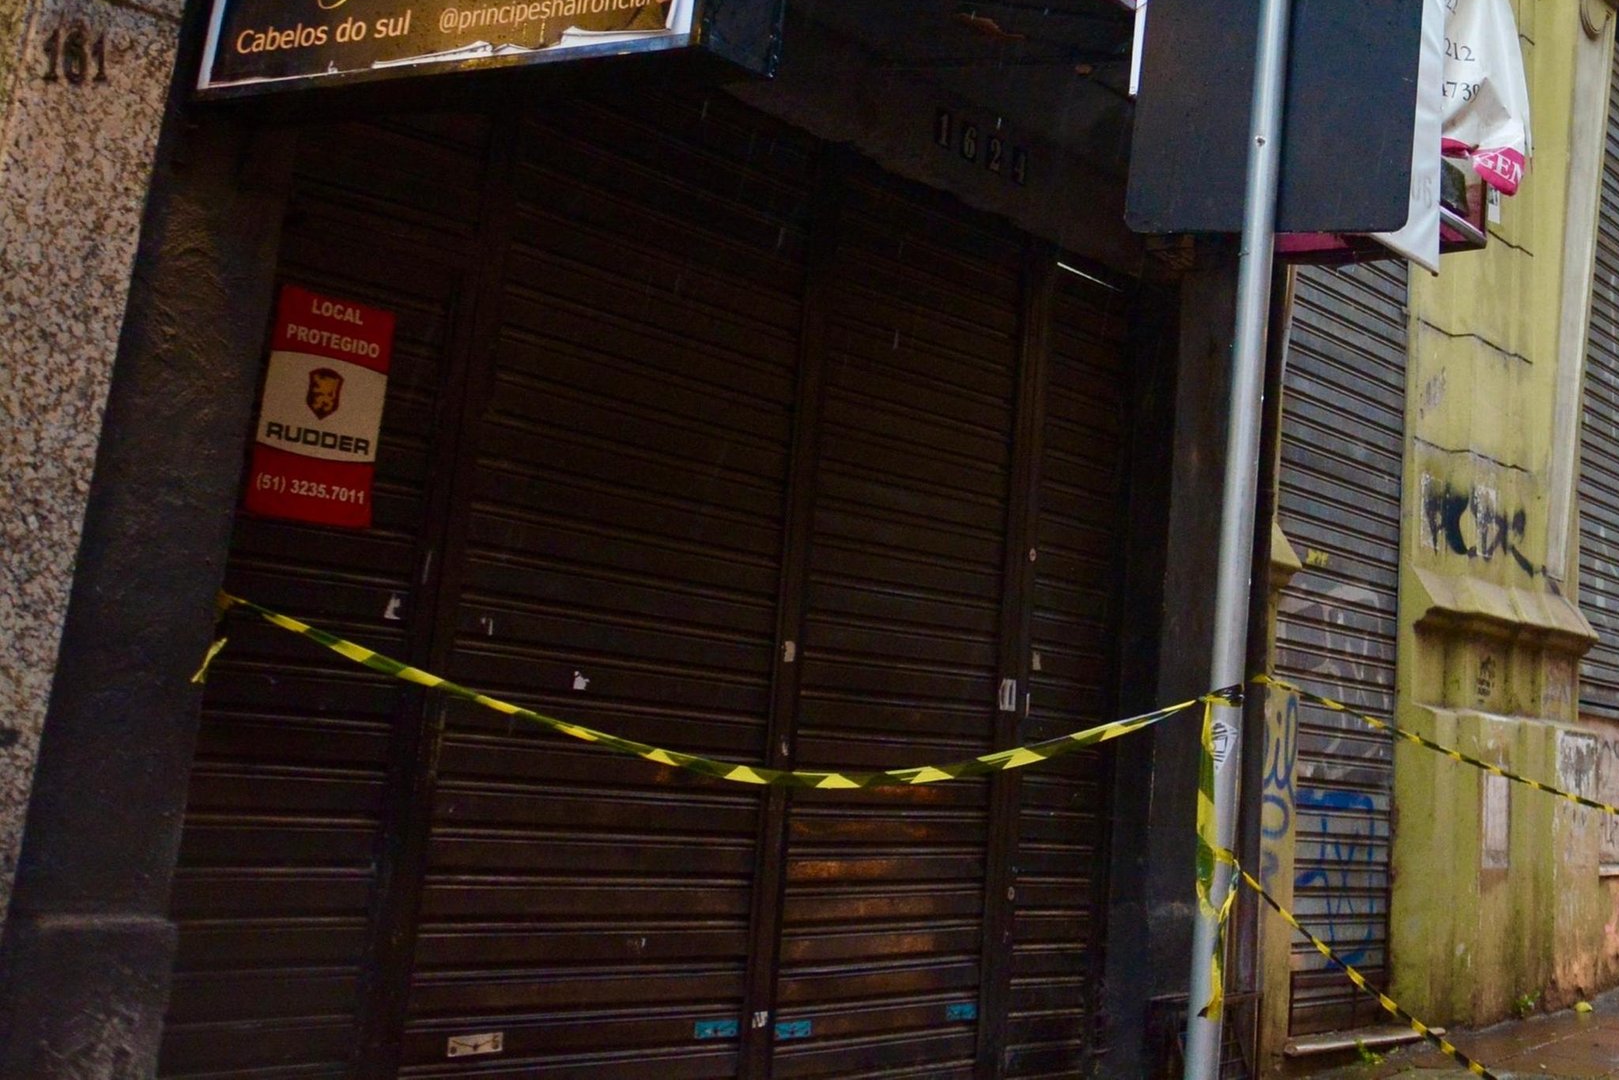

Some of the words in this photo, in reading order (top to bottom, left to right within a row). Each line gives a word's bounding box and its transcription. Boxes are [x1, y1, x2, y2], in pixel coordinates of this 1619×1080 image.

[236, 23, 328, 54] Cabelos
[335, 17, 366, 43] do
[374, 9, 412, 38] sul
[312, 298, 363, 325] LOCAL
[286, 323, 380, 358] PROTEGIDO
[266, 422, 370, 456] RUDDER
[256, 472, 287, 494] (51)
[290, 479, 365, 505] 3235.7011
